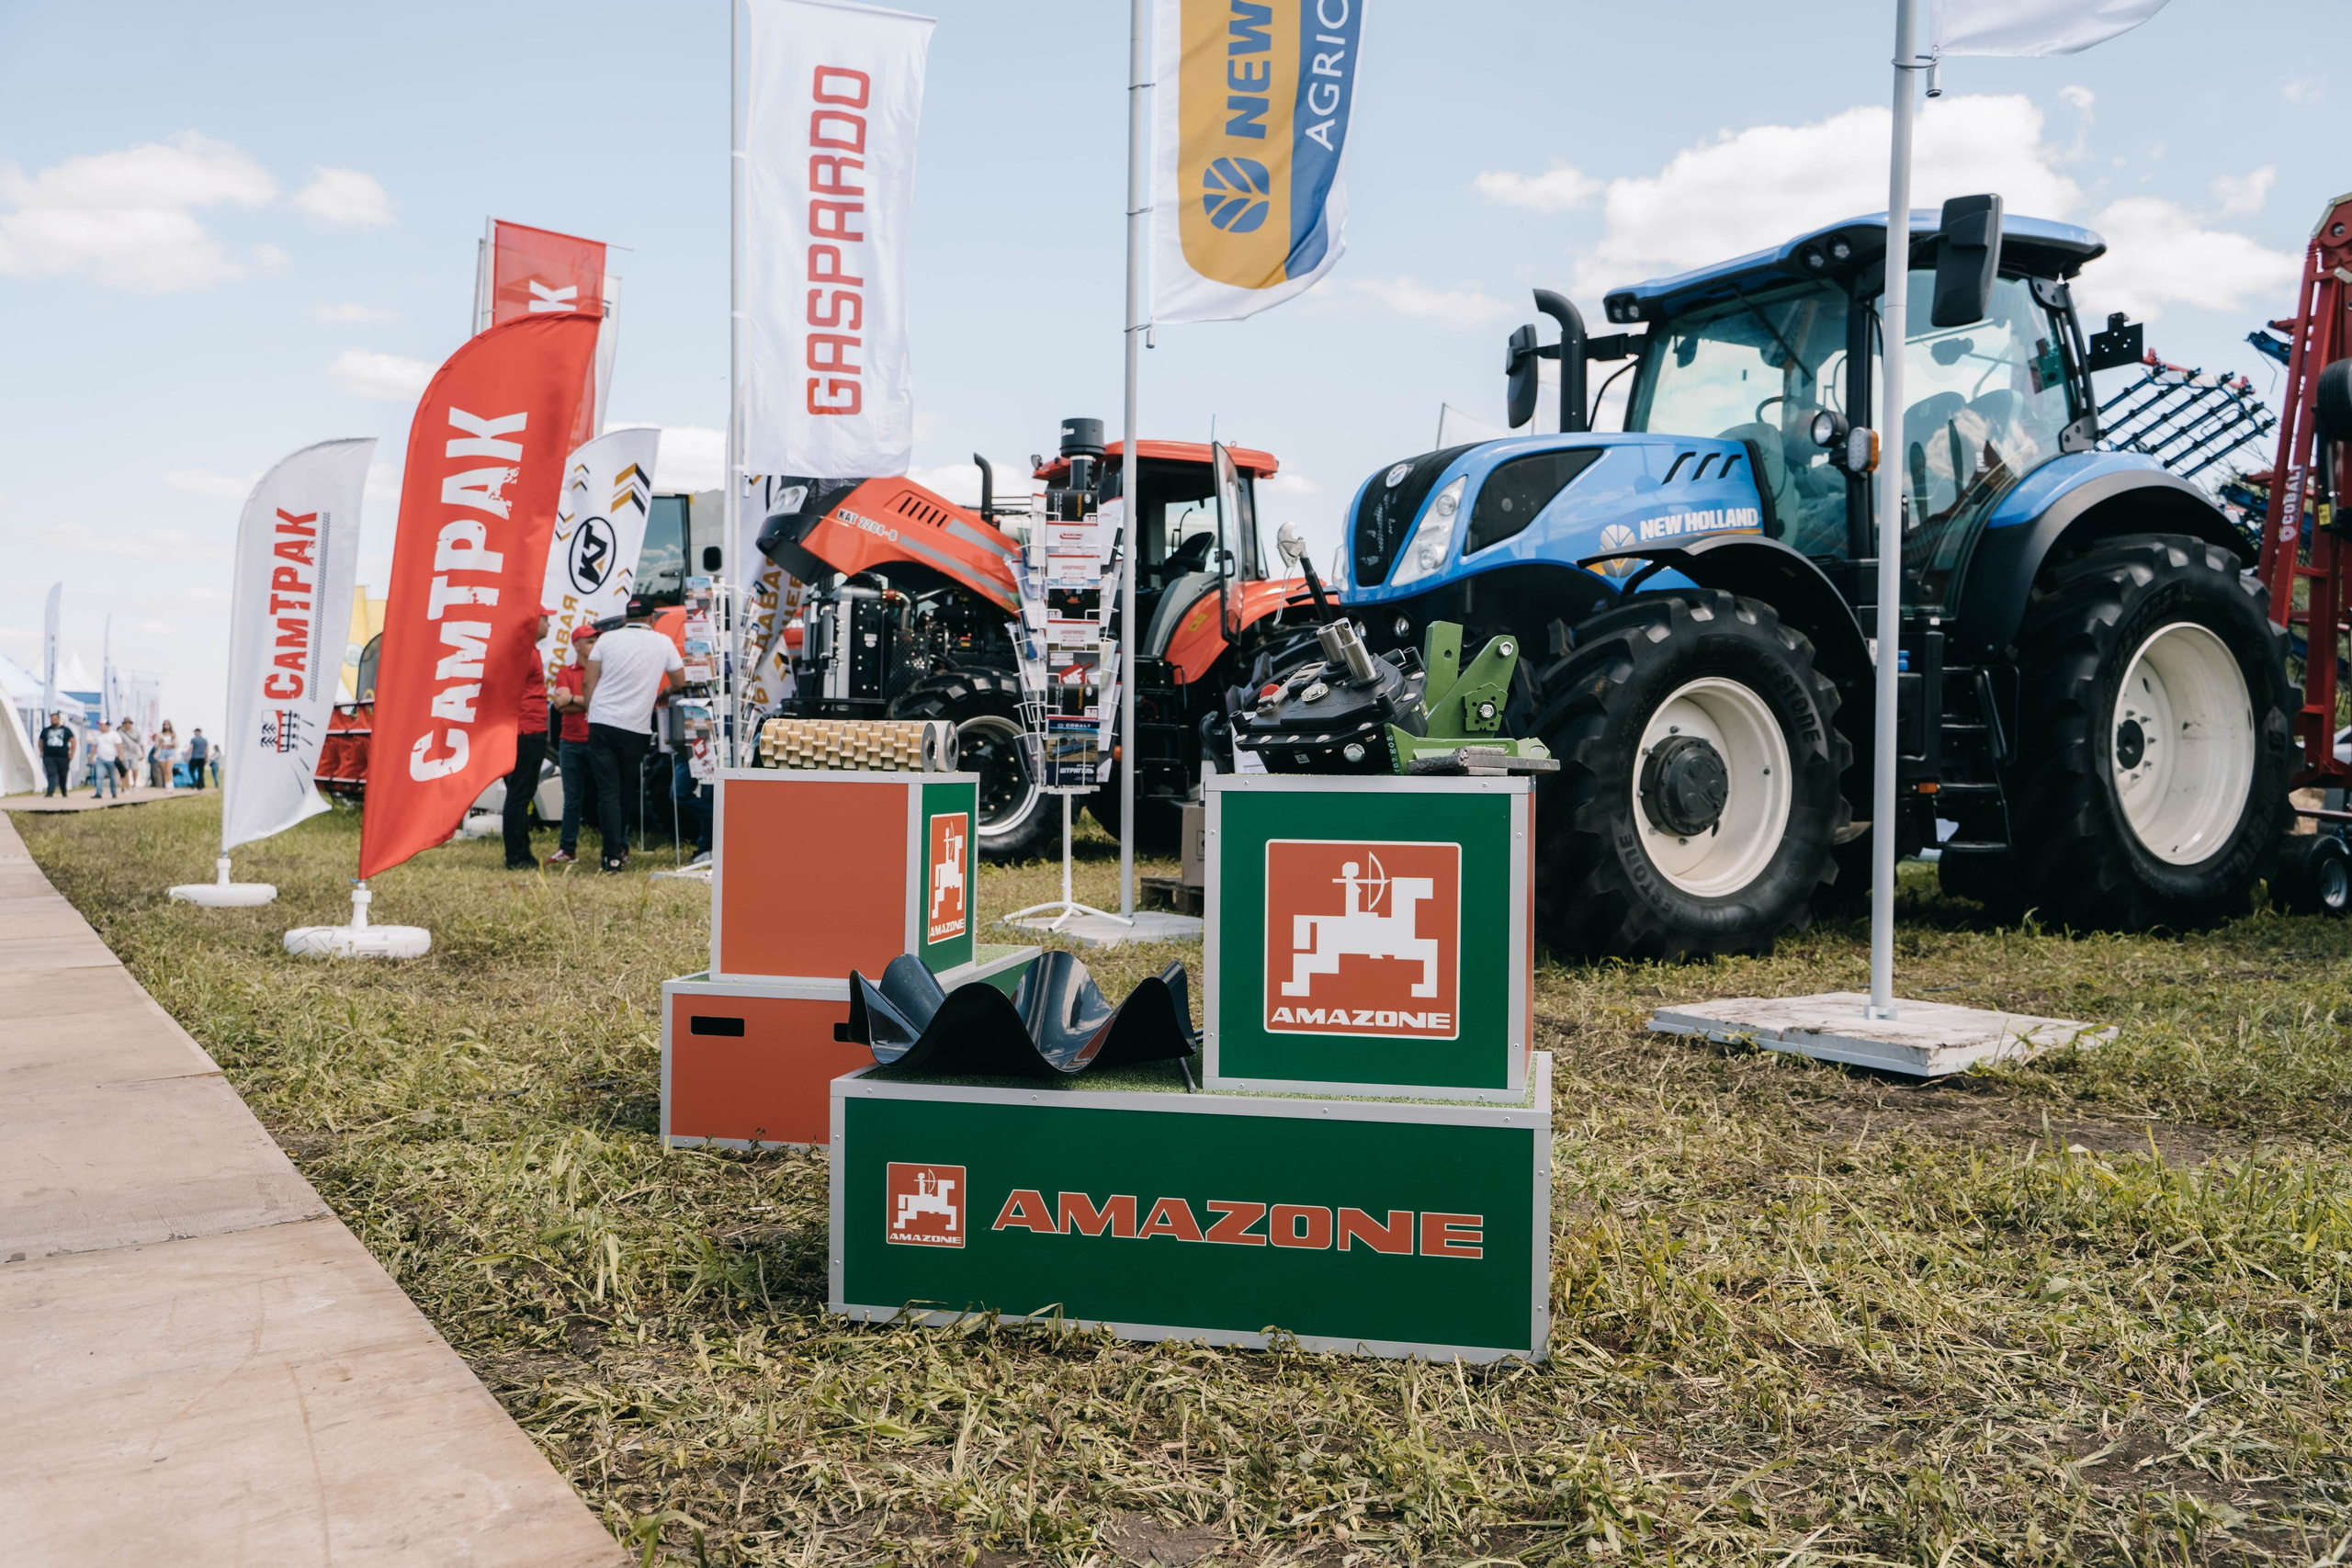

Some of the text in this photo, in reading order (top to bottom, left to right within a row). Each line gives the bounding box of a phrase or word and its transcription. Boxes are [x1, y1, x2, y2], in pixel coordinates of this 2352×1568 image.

[1226, 0, 1272, 140] NEW
[807, 65, 870, 416] GASPARDO
[1640, 507, 1759, 541] NEW HOLLAND
[2281, 465, 2301, 525] COBALT
[265, 507, 318, 701] САМТРАК
[410, 406, 528, 782] САМТРАК
[929, 918, 965, 937] AMAZONE
[1271, 1007, 1451, 1030] AMAZONE
[889, 1233, 962, 1244] AMAZONE
[991, 1189, 1483, 1259] AMAZONE
